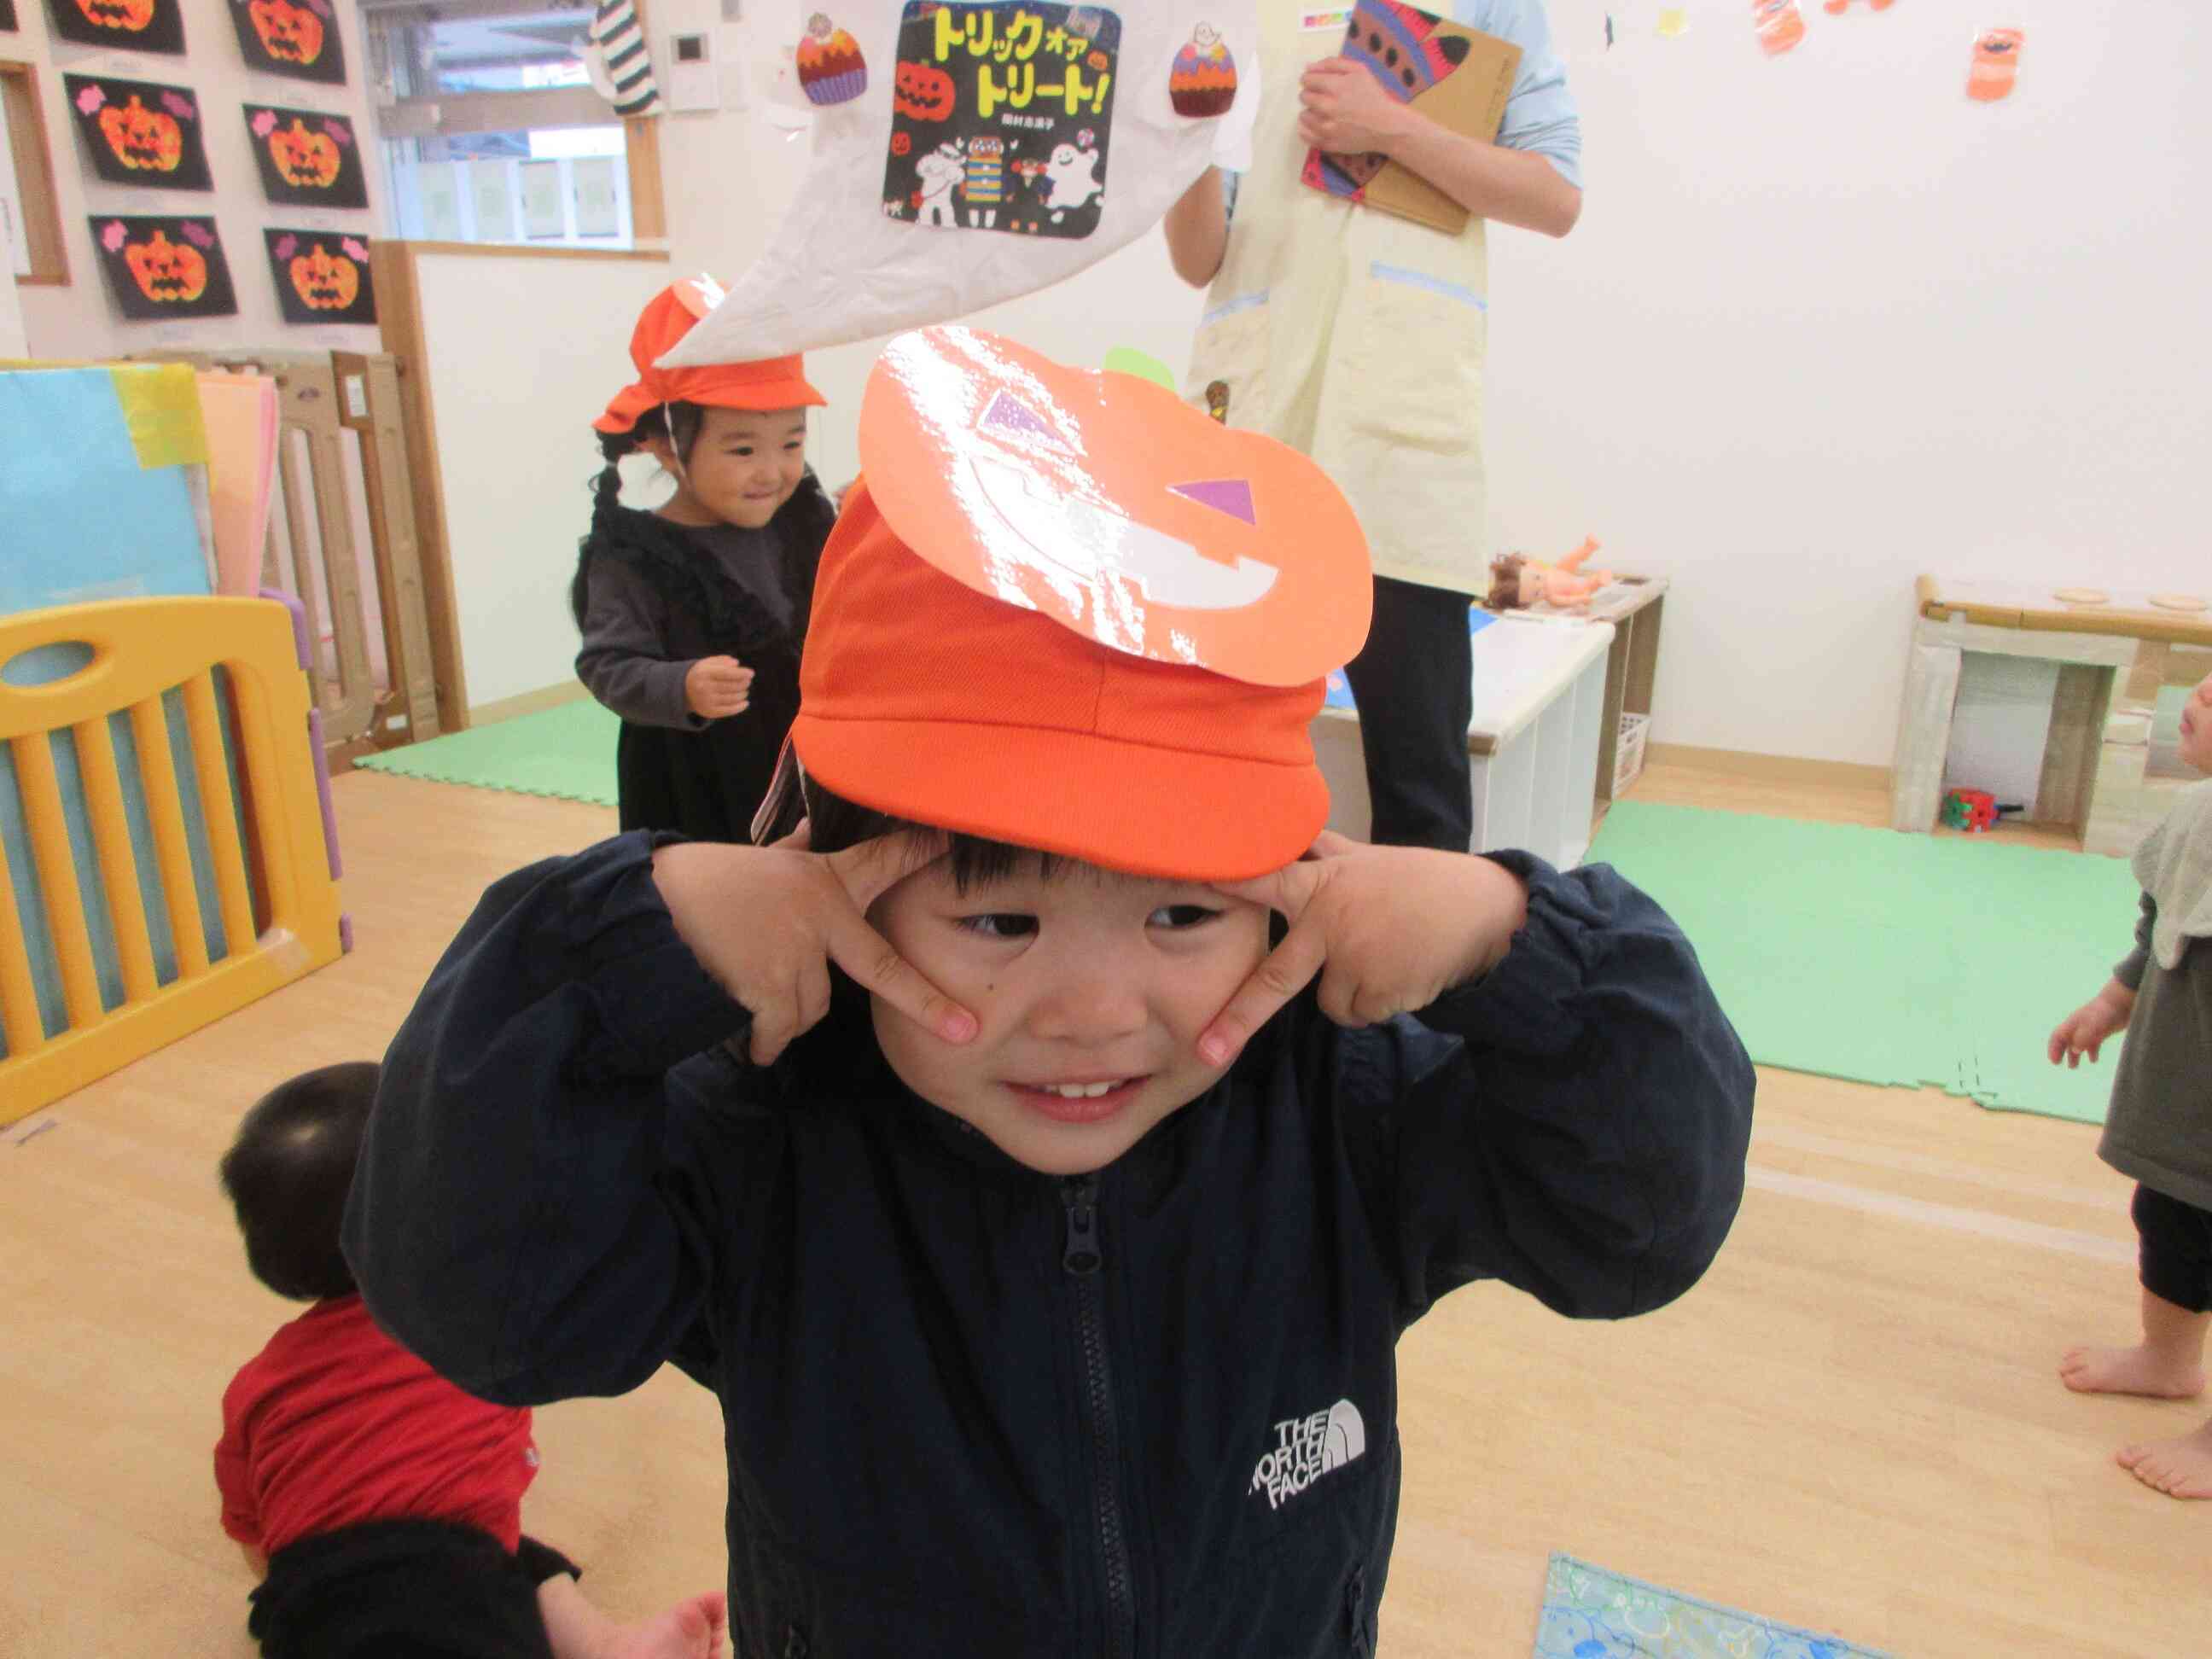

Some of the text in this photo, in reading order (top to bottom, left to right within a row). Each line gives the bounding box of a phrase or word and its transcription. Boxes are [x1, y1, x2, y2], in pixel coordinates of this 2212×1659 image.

[978, 63, 1110, 119] トリート!
[1274, 1409, 1330, 1448] THE
[1267, 1460, 1324, 1510] FACE
